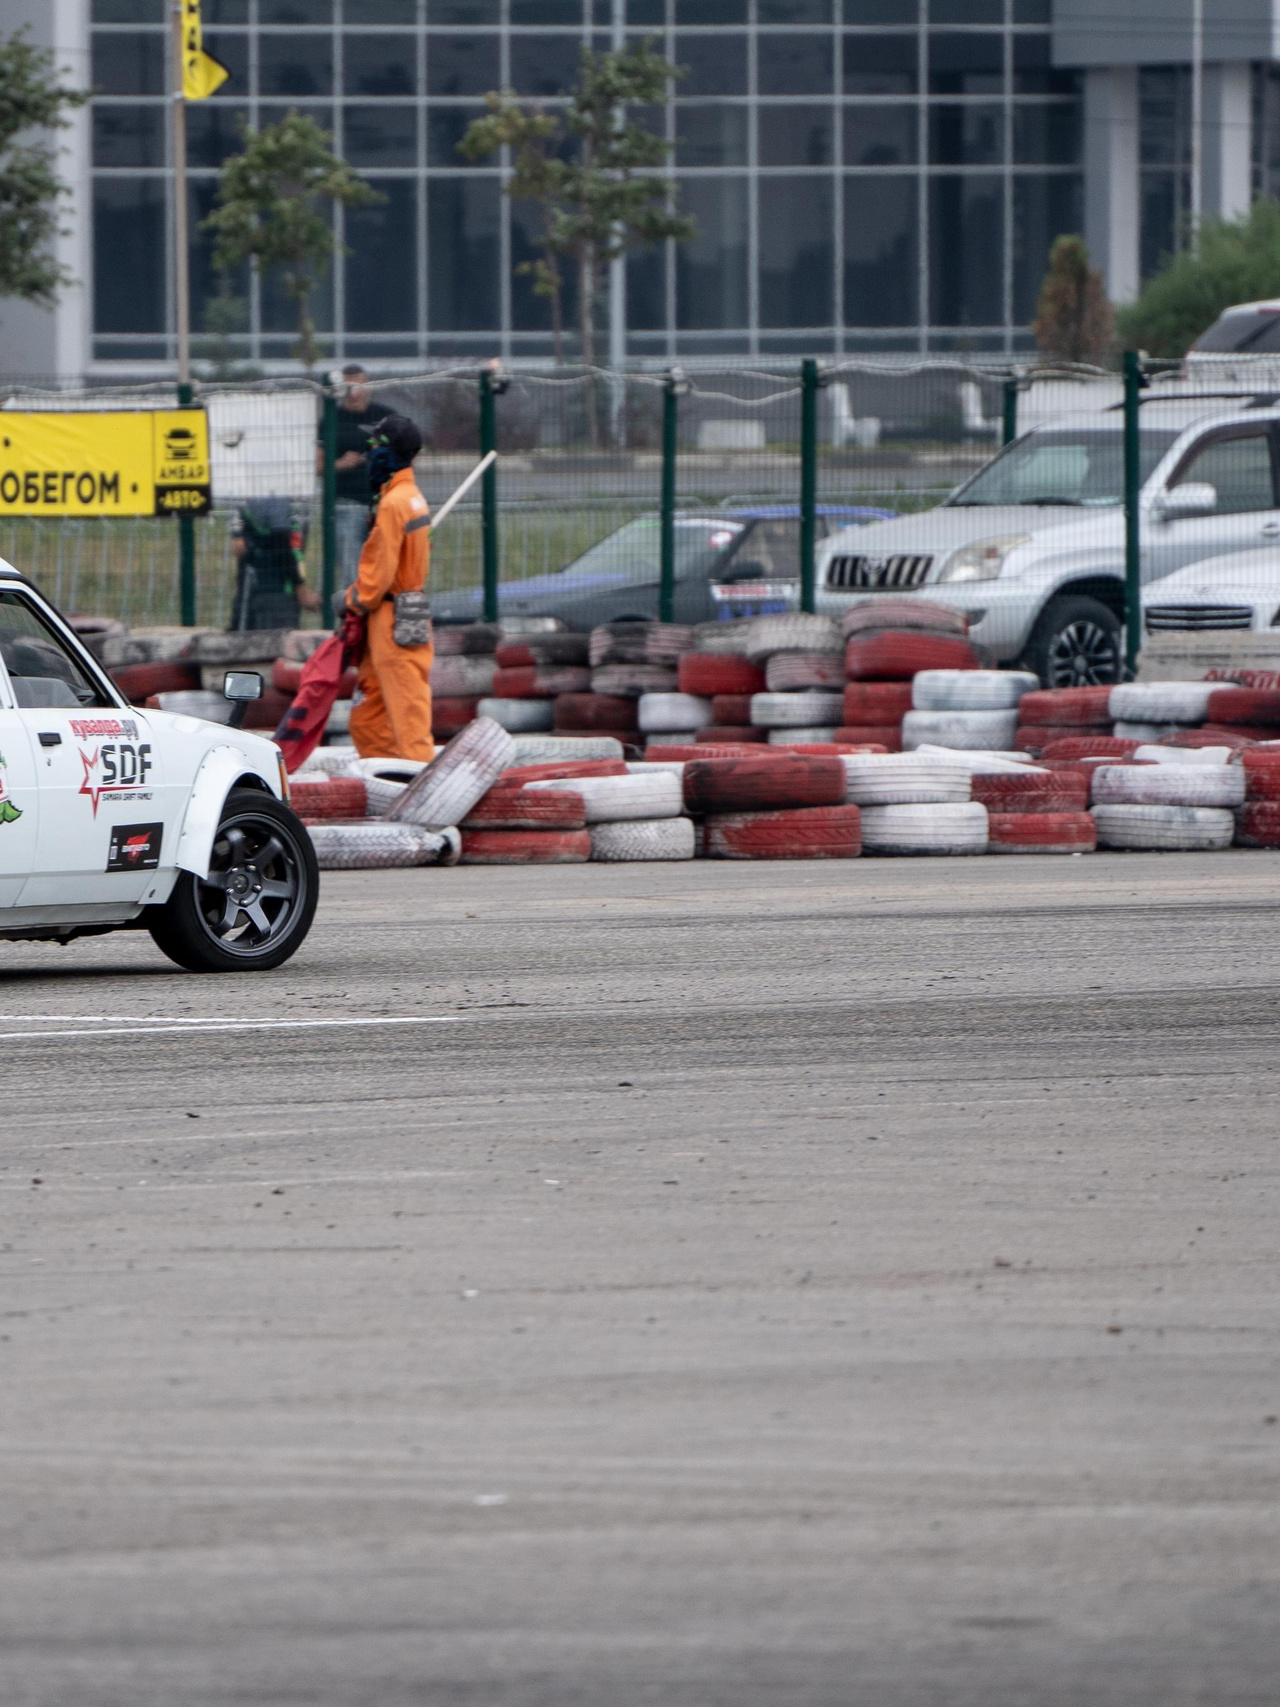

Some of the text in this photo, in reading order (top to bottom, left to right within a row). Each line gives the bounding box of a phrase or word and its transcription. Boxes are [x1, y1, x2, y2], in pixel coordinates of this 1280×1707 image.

[159, 464, 205, 479] АМБАР
[163, 489, 202, 509] АВТО
[101, 743, 153, 786] SDF
